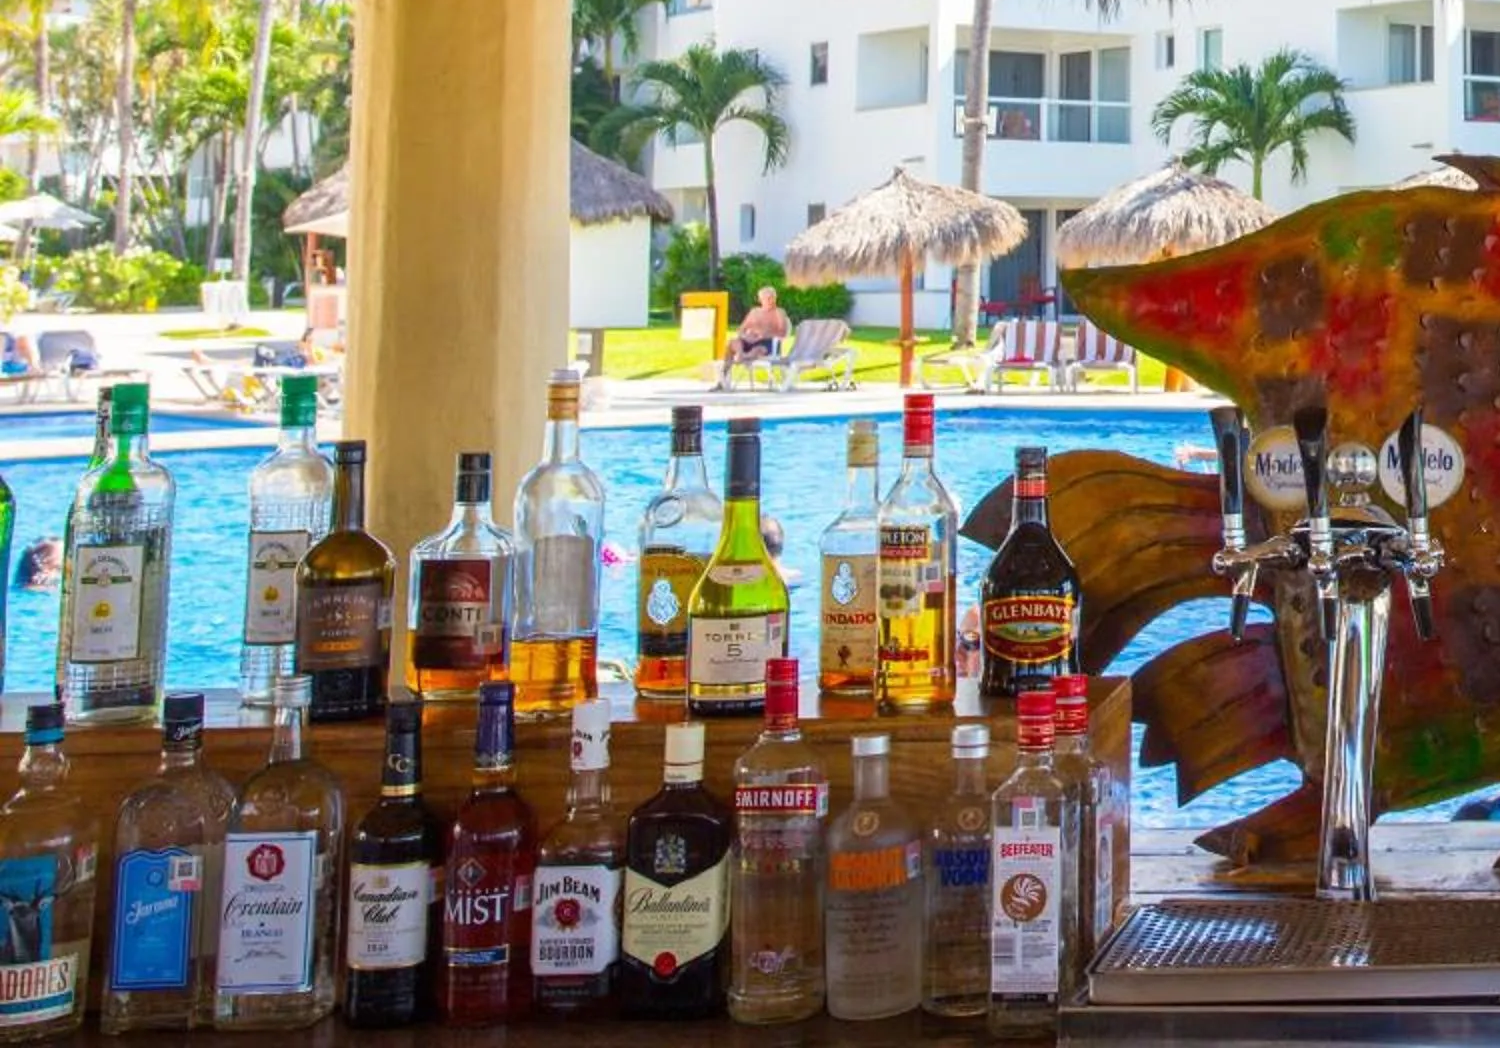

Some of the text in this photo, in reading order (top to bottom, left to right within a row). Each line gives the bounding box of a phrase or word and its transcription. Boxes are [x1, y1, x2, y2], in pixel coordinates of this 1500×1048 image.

[1255, 452, 1304, 477] Mode
[422, 607, 482, 623] CONTI
[727, 643, 743, 657] 5
[736, 790, 812, 807] SMIRNOFF
[1001, 843, 1054, 857] BEEFEATER
[536, 876, 601, 905] JIM BEAM
[362, 904, 400, 924] Club
[444, 893, 509, 925] MIST
[539, 945, 595, 961] BOURBON
